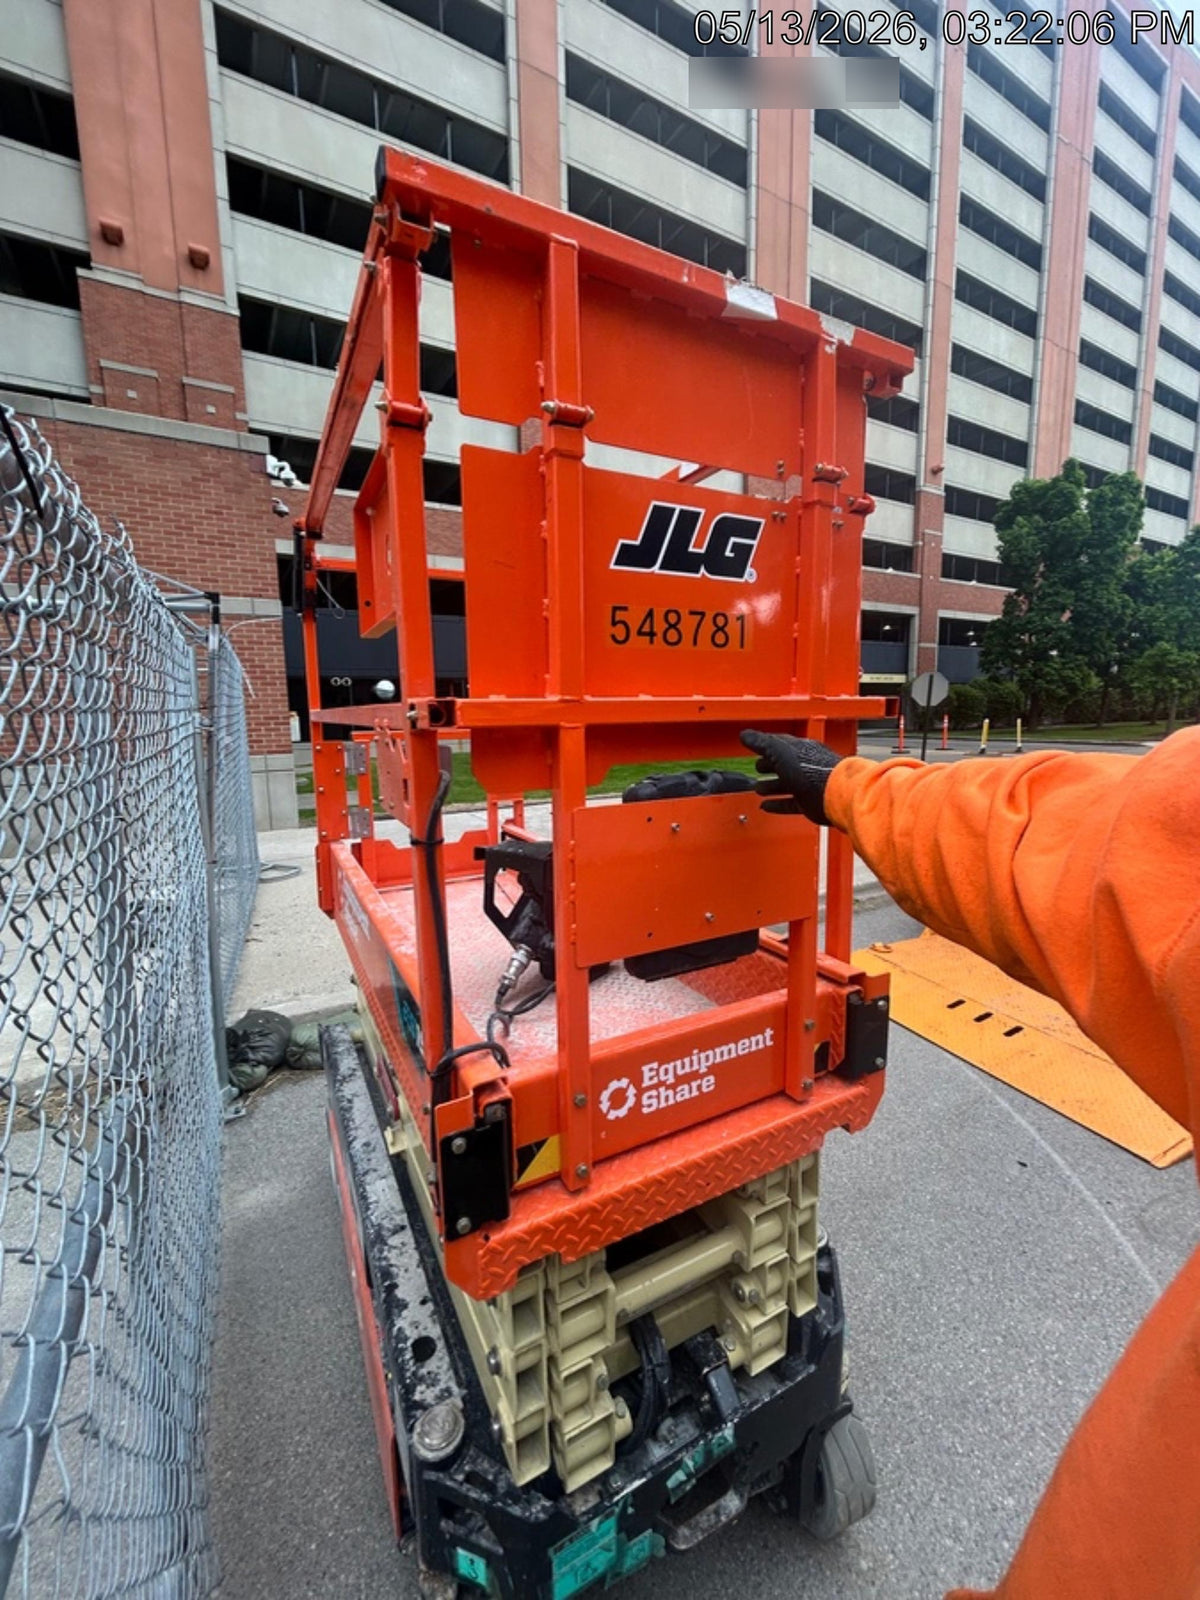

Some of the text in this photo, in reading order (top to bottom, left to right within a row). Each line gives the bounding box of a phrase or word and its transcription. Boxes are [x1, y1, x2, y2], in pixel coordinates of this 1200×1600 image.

[610, 605, 746, 649] 548781
[641, 1028, 774, 1087] Equipment
[642, 1075, 715, 1114] Share
